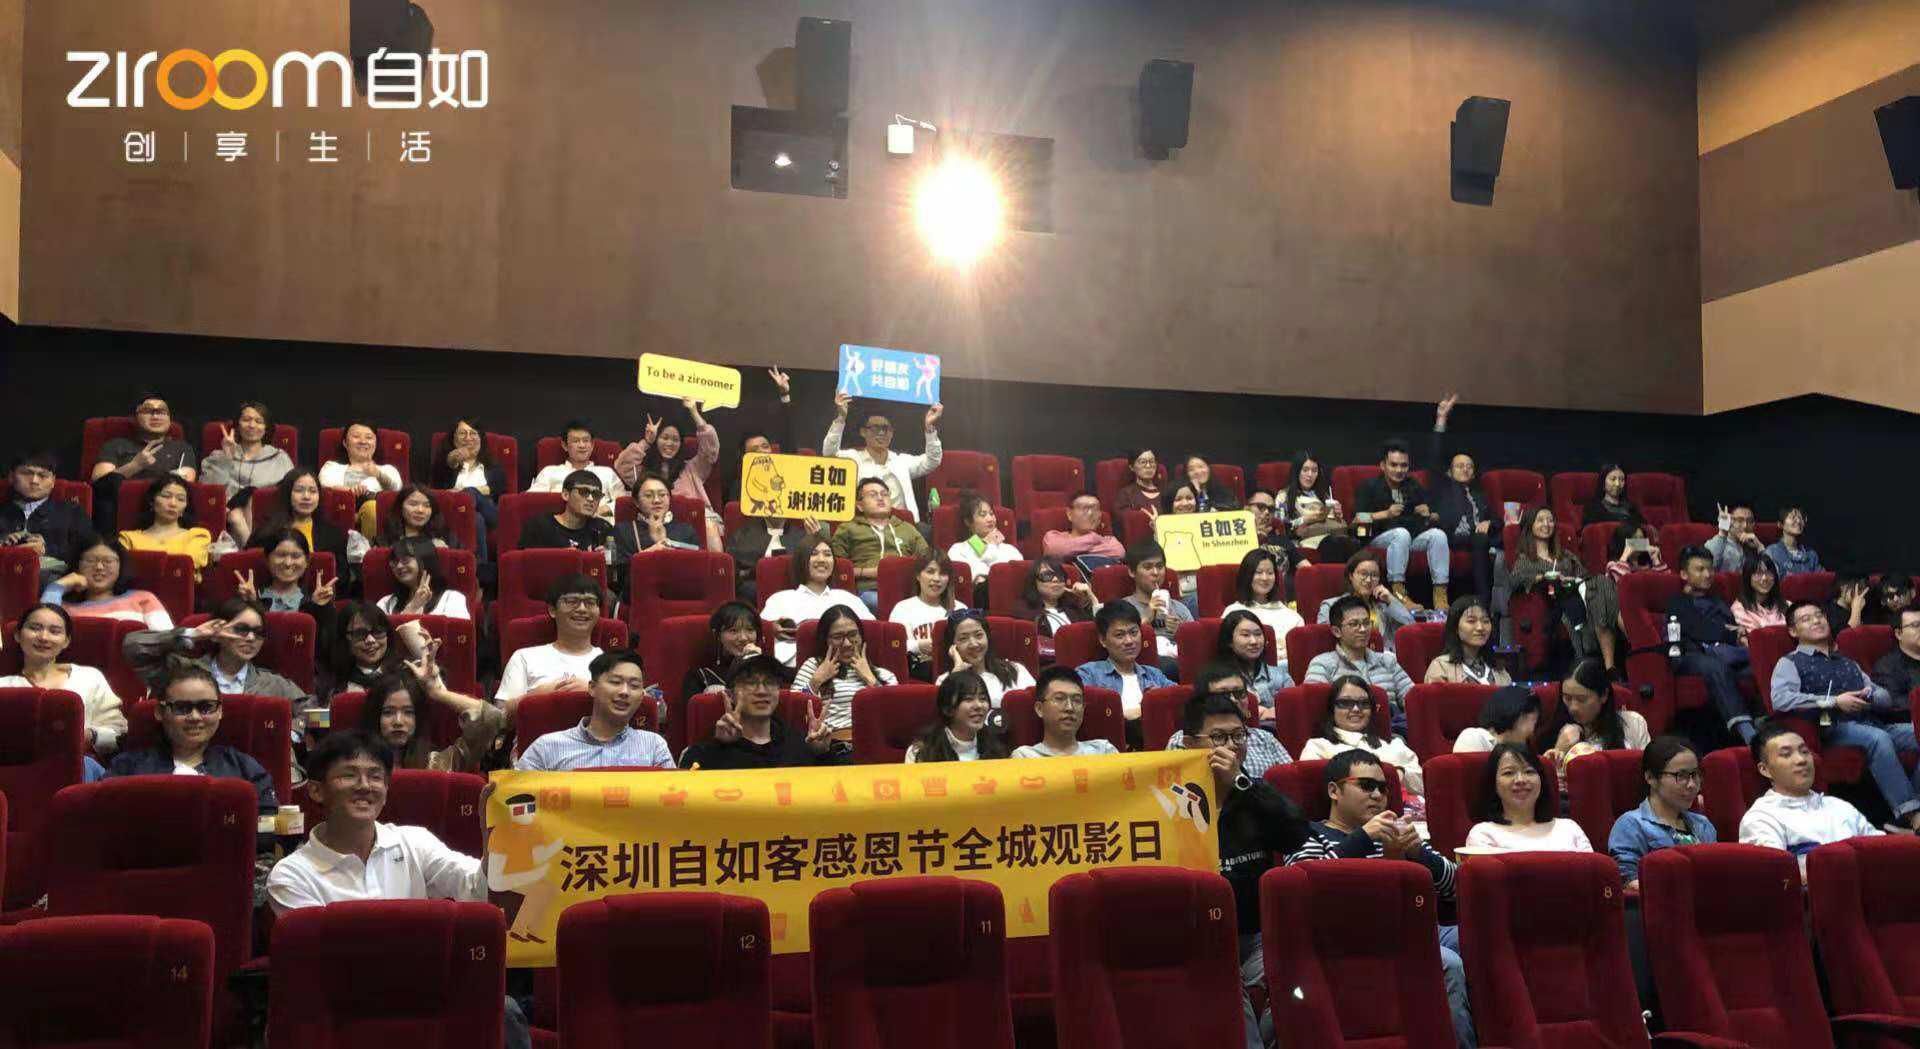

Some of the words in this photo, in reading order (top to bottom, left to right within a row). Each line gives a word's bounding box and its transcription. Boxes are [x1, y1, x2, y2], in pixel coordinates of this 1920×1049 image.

[647, 366, 660, 377] To
[662, 368, 676, 379] be
[678, 374, 685, 382] a
[687, 372, 735, 390] ziroomer
[810, 464, 847, 486] 自如
[787, 491, 846, 513] 谢谢你
[1200, 518, 1247, 538] 自如客
[460, 804, 472, 816] 13
[560, 820, 1162, 892] 深圳自如客感恩节全城观影日
[1783, 879, 1790, 890] 7
[1604, 886, 1612, 899] 8
[1415, 895, 1424, 908] 9
[1208, 907, 1222, 920] 10
[980, 919, 992, 934] 11
[740, 934, 755, 949] 12
[469, 945, 486, 961] 13
